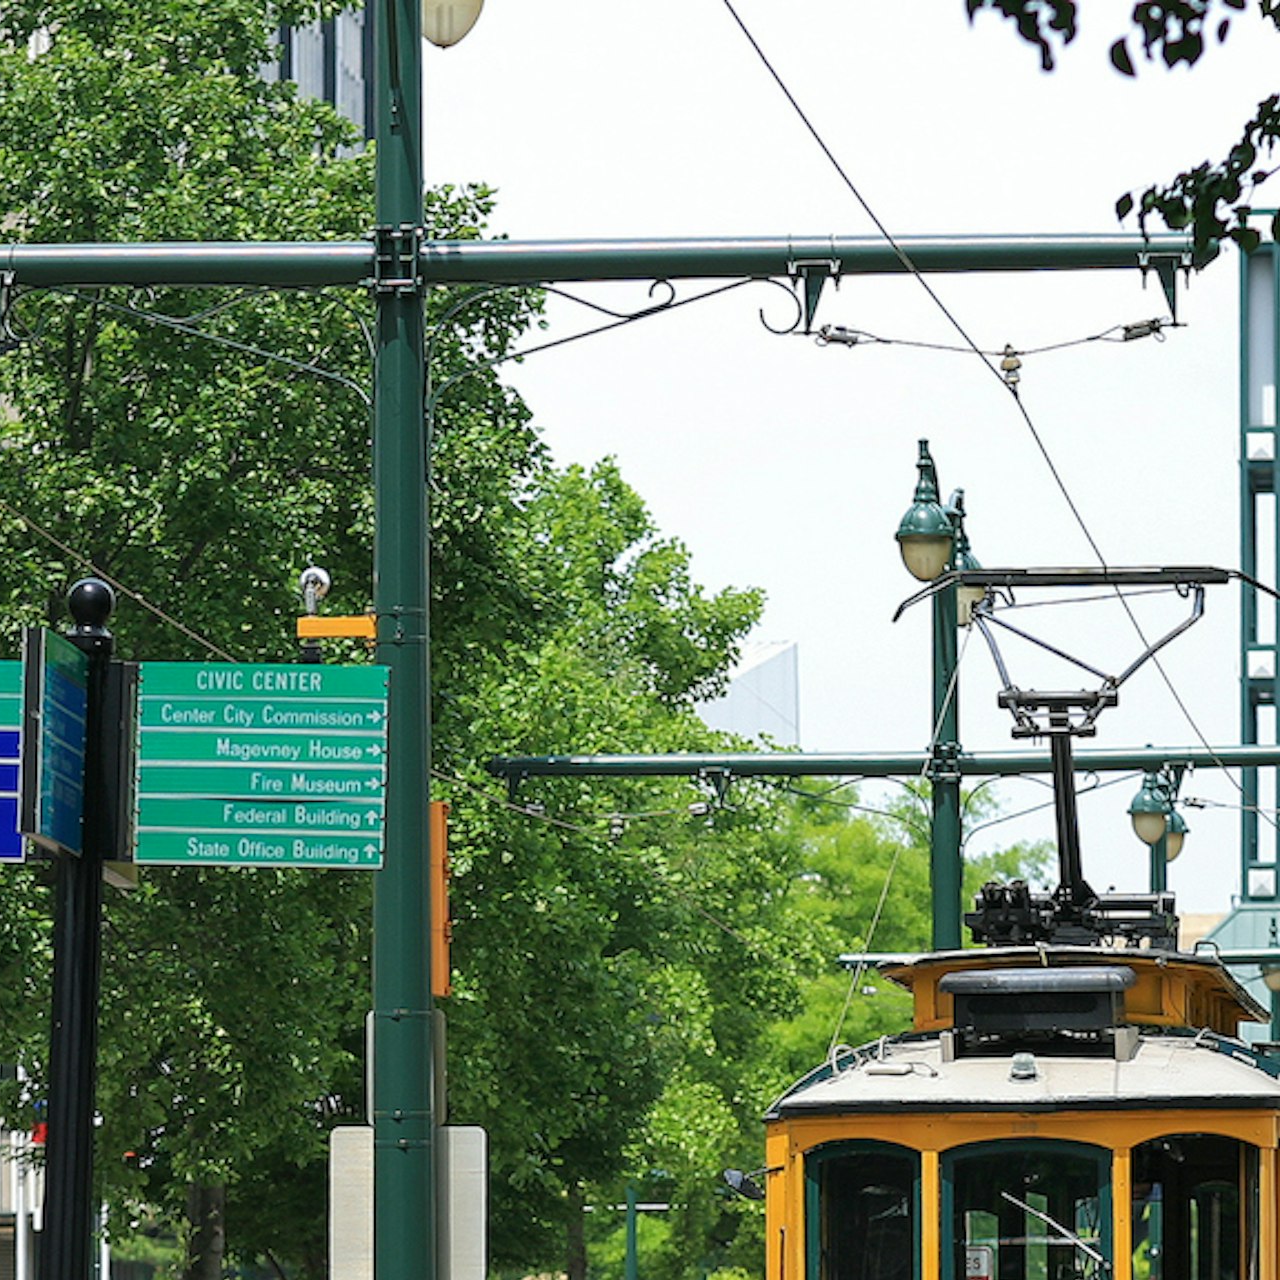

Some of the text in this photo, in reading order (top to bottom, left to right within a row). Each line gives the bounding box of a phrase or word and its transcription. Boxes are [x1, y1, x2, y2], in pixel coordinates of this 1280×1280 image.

[196, 670, 322, 691] CIVIC CENTER
[161, 703, 363, 726] Center City Commission
[216, 738, 363, 760] Magevney House
[250, 772, 361, 793] Fire Museum
[223, 804, 361, 828] Federal Building
[187, 837, 359, 863] State Office Building
